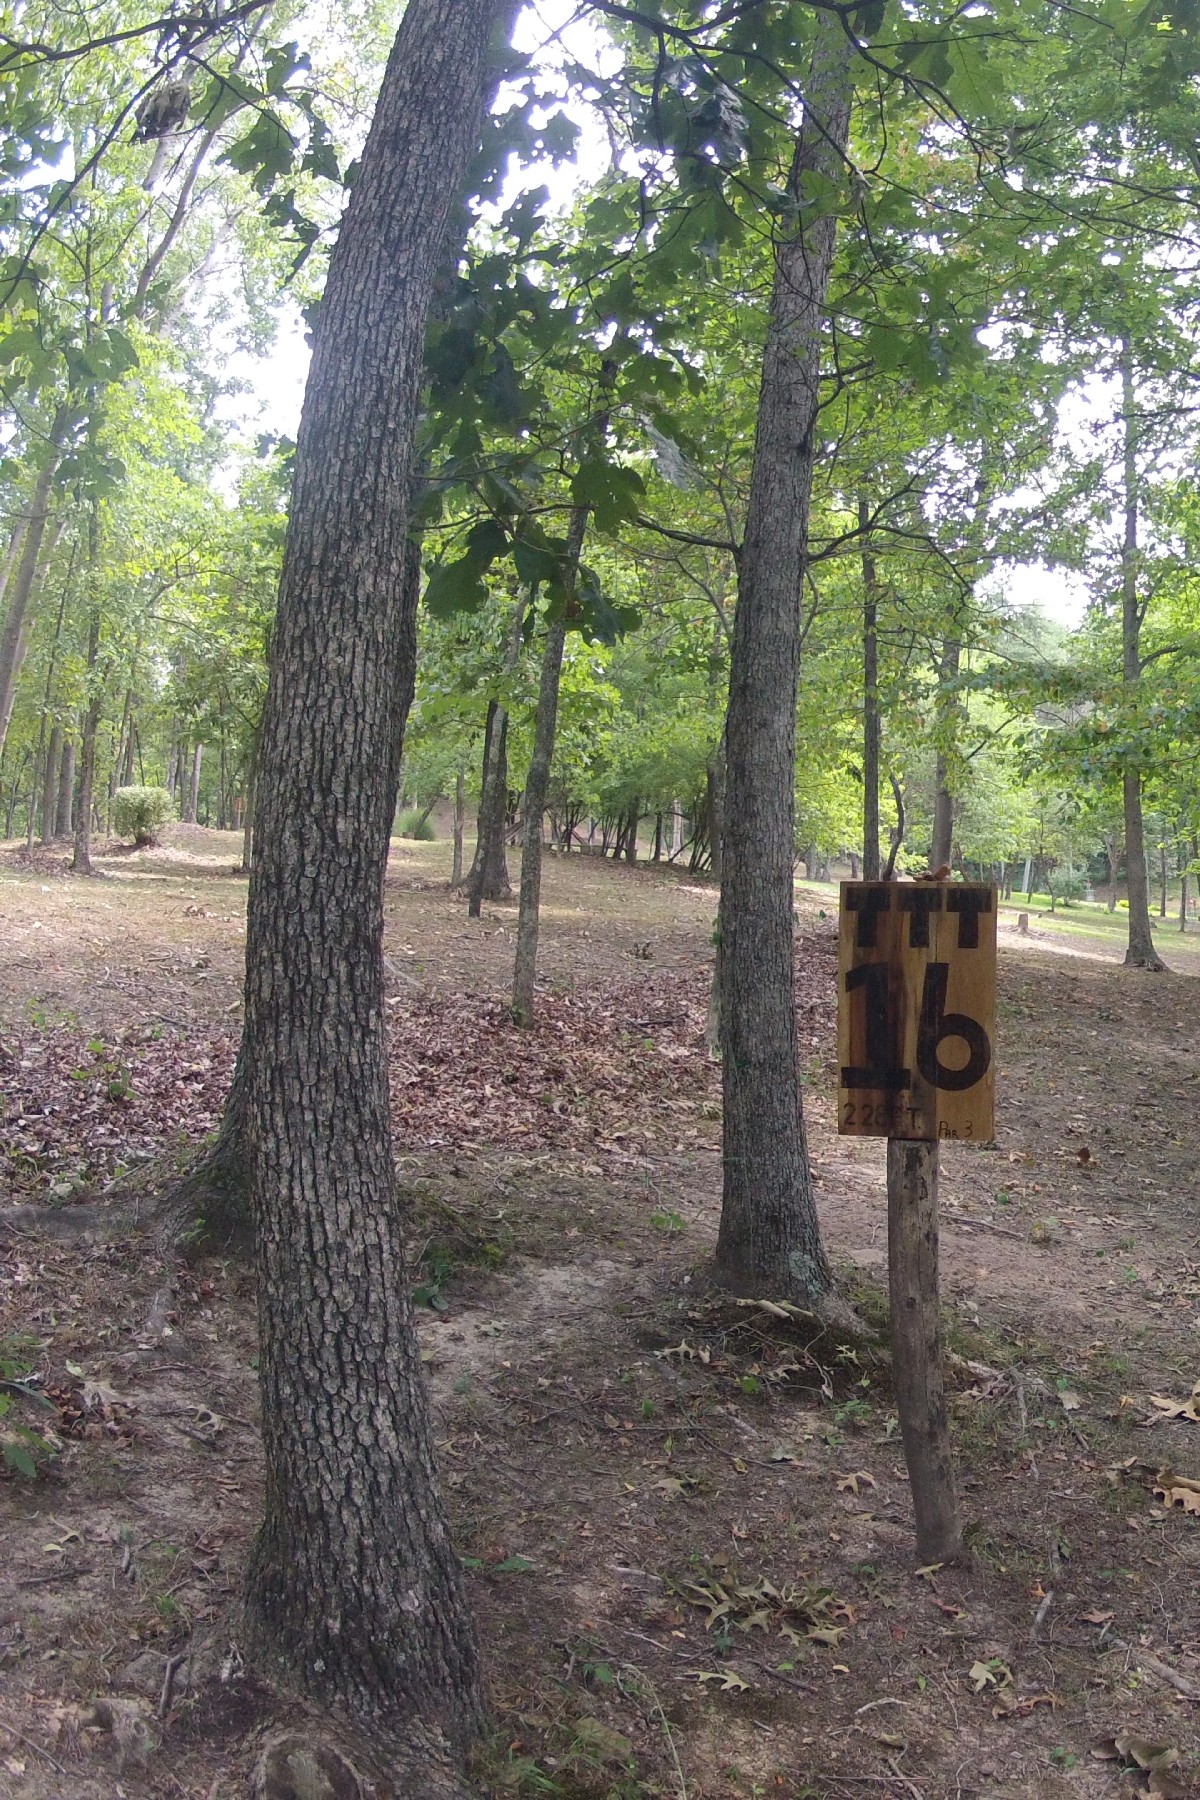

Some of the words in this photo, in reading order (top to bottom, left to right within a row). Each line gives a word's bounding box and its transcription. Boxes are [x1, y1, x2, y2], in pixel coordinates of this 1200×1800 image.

[845, 887, 992, 948] TTT
[841, 962, 991, 1091] 16
[964, 1120, 974, 1138] 3
